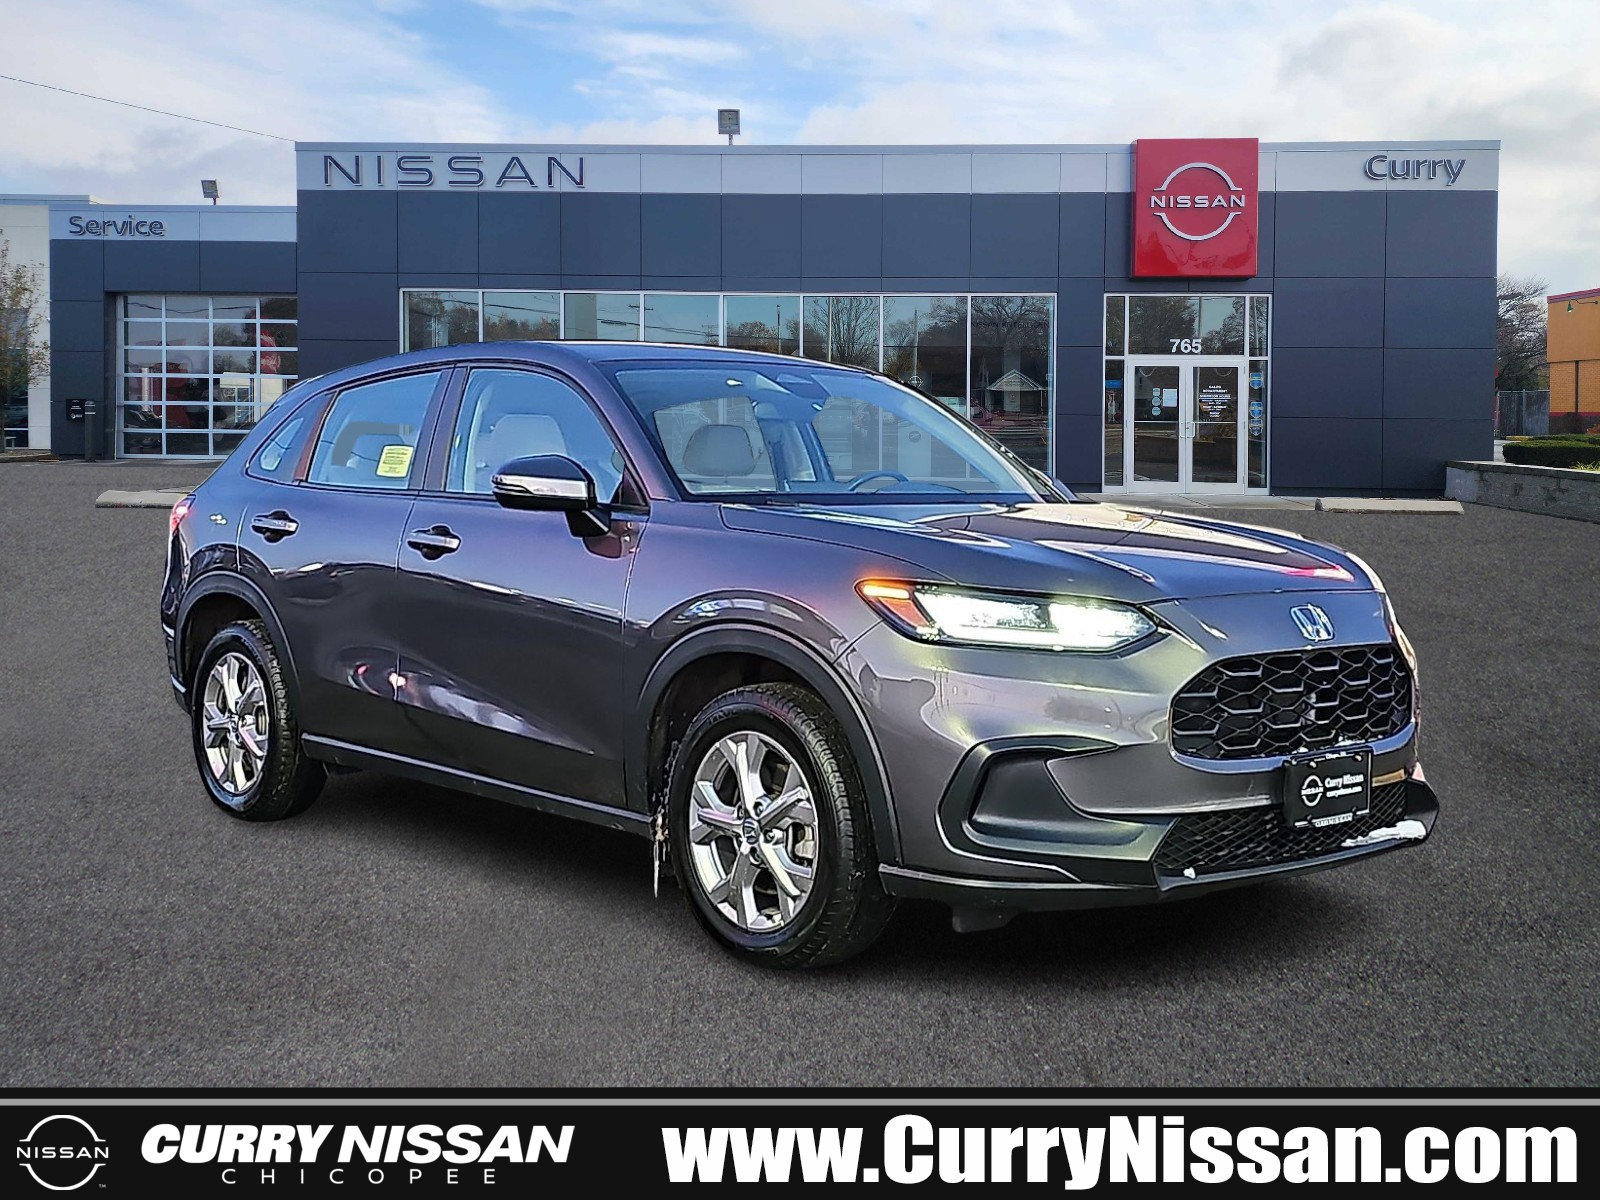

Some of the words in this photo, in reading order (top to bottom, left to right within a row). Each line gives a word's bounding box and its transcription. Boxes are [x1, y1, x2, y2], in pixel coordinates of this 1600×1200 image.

[323, 154, 586, 188] NISSAN
[1364, 154, 1467, 187] Curry
[1150, 194, 1246, 208] NISSAN
[68, 214, 166, 237] Service
[1169, 338, 1203, 354] 765
